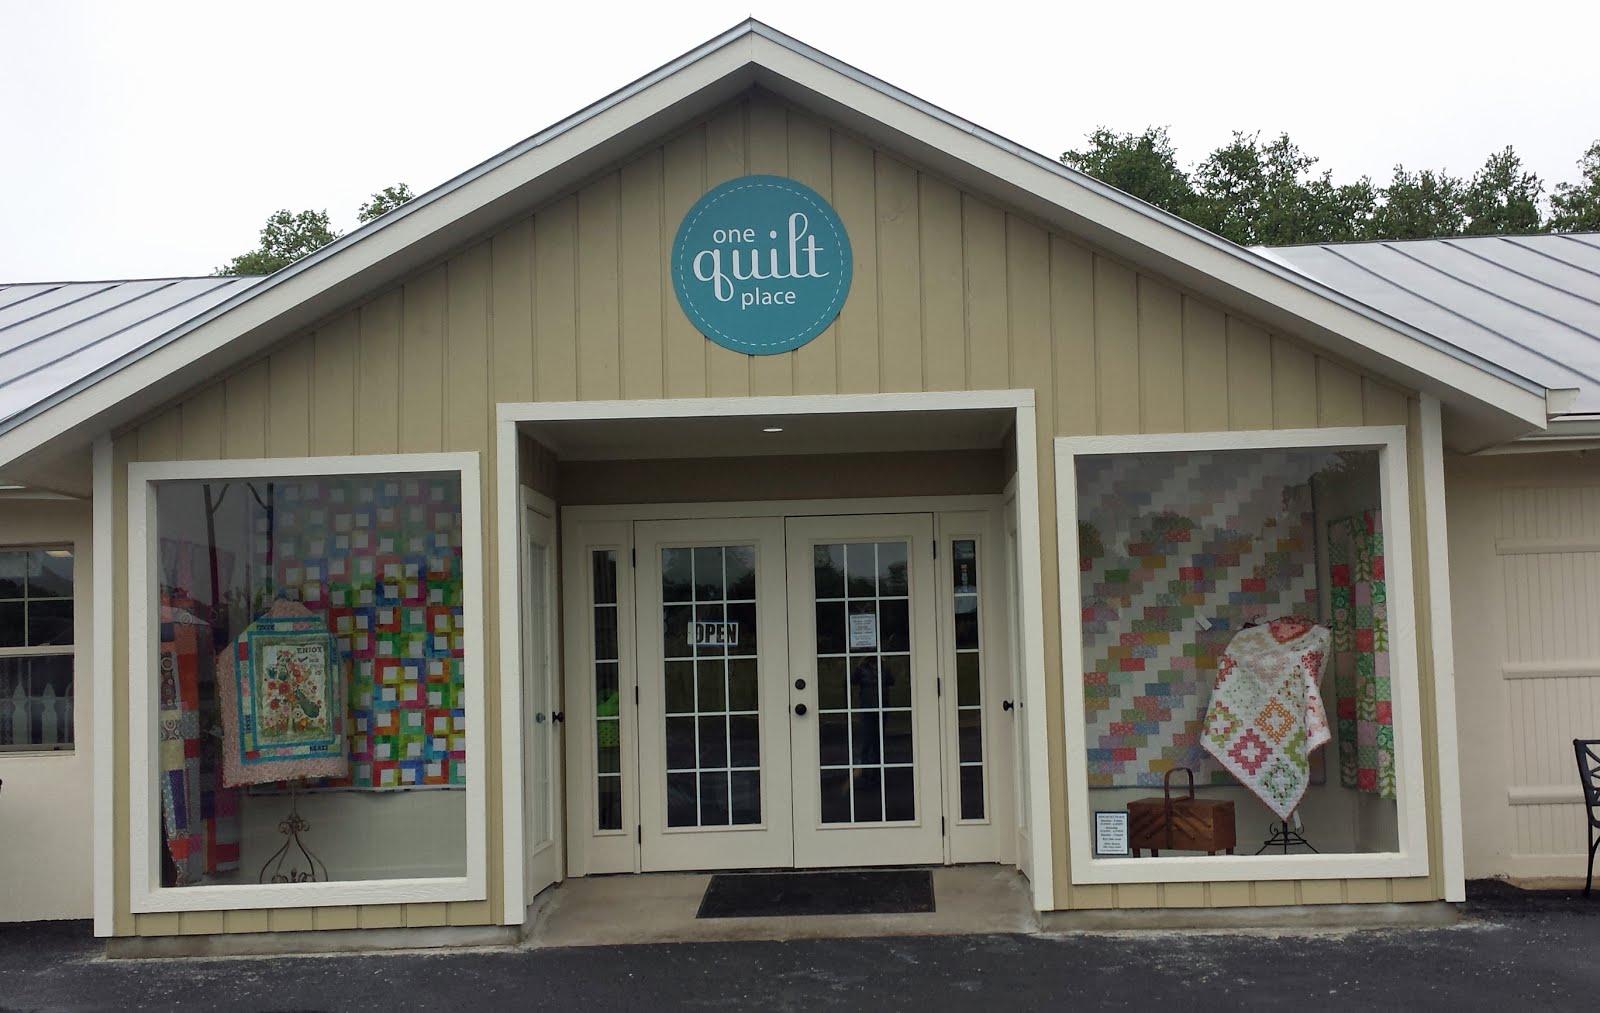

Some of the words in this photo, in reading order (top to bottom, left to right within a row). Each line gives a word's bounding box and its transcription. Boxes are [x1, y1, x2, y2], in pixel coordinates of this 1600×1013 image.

[712, 228, 756, 244] one
[692, 212, 830, 302] quilt
[741, 287, 796, 311] place
[695, 623, 737, 643] OPEN
